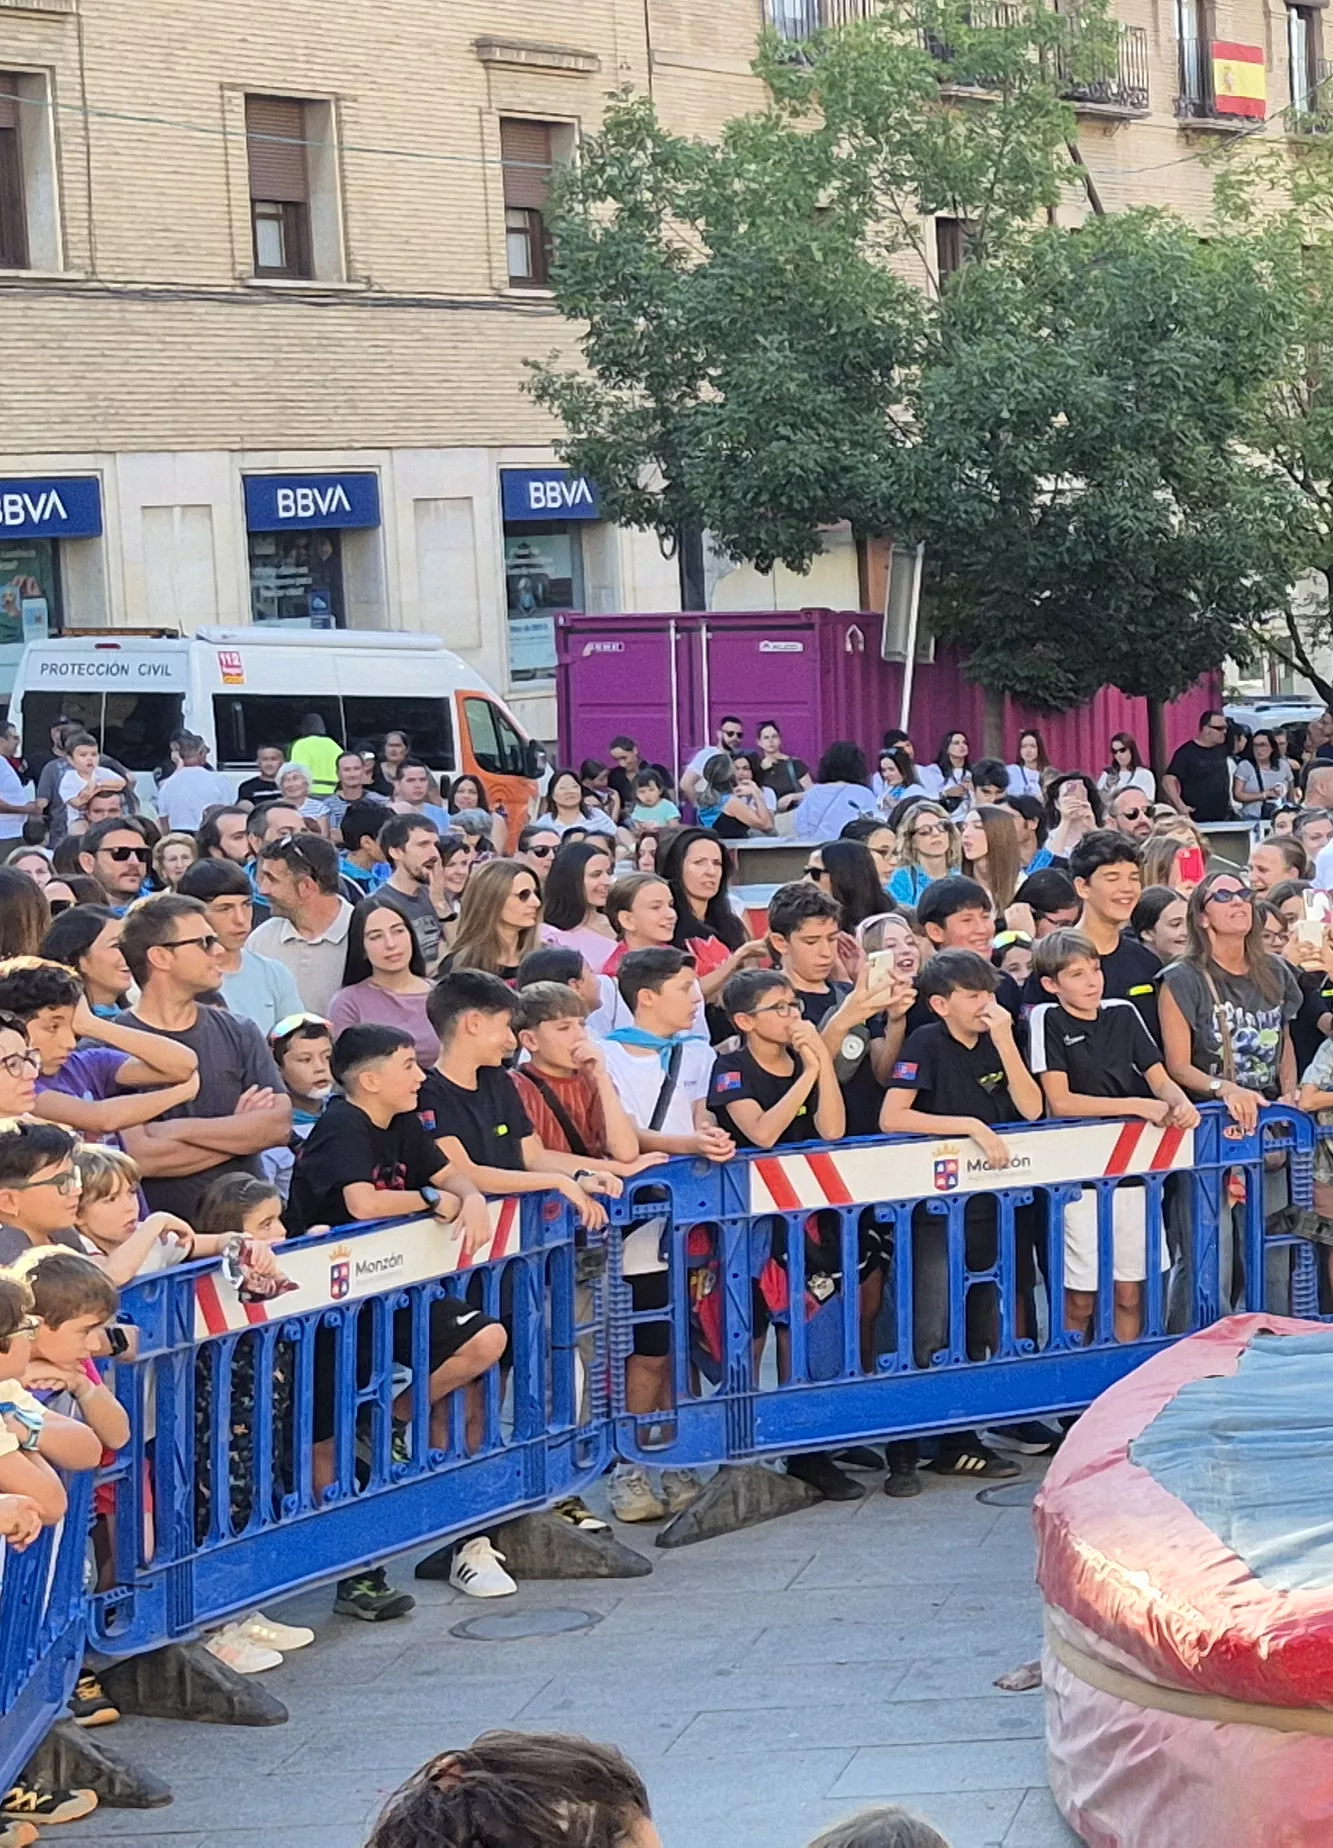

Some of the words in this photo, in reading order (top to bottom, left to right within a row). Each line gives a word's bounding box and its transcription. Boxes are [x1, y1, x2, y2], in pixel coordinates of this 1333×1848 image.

[0, 489, 68, 526] BVA
[276, 484, 351, 518] BBVA
[529, 477, 593, 509] BBVA
[40, 660, 130, 677] PROTECCIÓN
[138, 663, 172, 677] CIVIL
[966, 1154, 1031, 1172] Moón
[355, 1251, 404, 1277] Monzón
